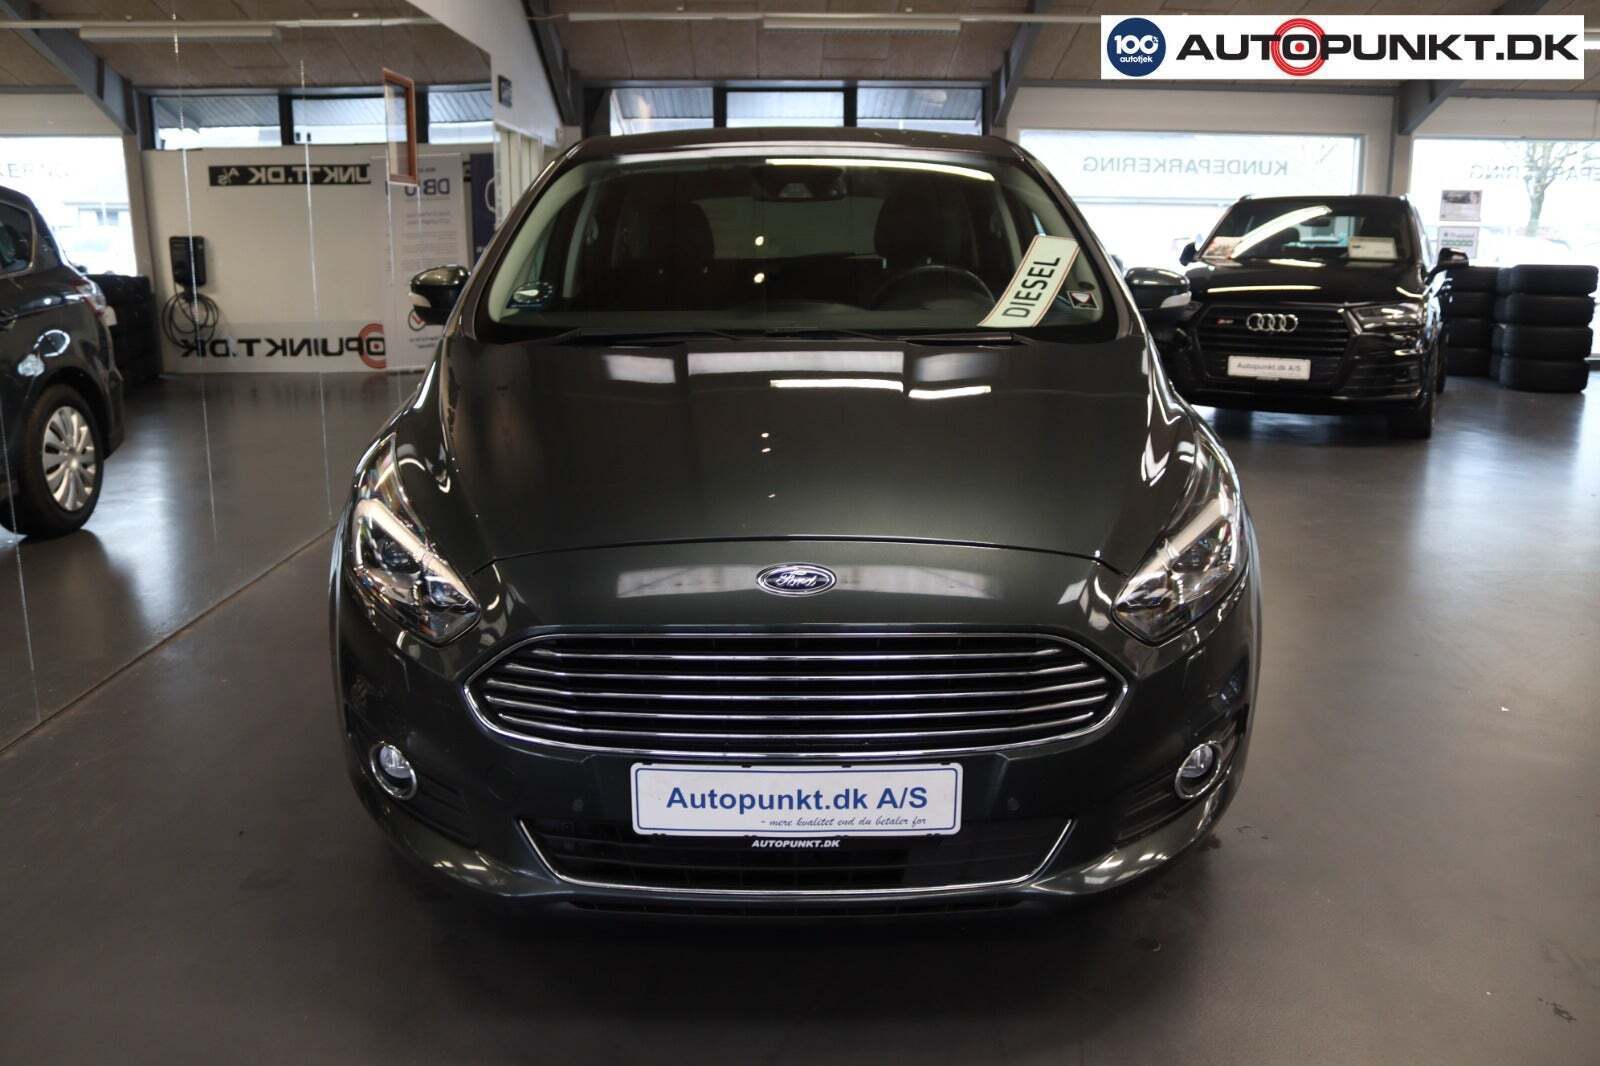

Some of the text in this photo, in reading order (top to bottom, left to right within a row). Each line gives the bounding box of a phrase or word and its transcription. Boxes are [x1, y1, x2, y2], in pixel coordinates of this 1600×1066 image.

[1001, 257, 1061, 318] DIESEL
[666, 786, 928, 815] Autopunkt.dk A/S
[769, 819, 793, 827] mere
[837, 816, 855, 827] end
[858, 816, 872, 827] du
[875, 815, 909, 826] betaler
[911, 815, 927, 829] for
[751, 840, 841, 848] AUTOPUNKT.DK
